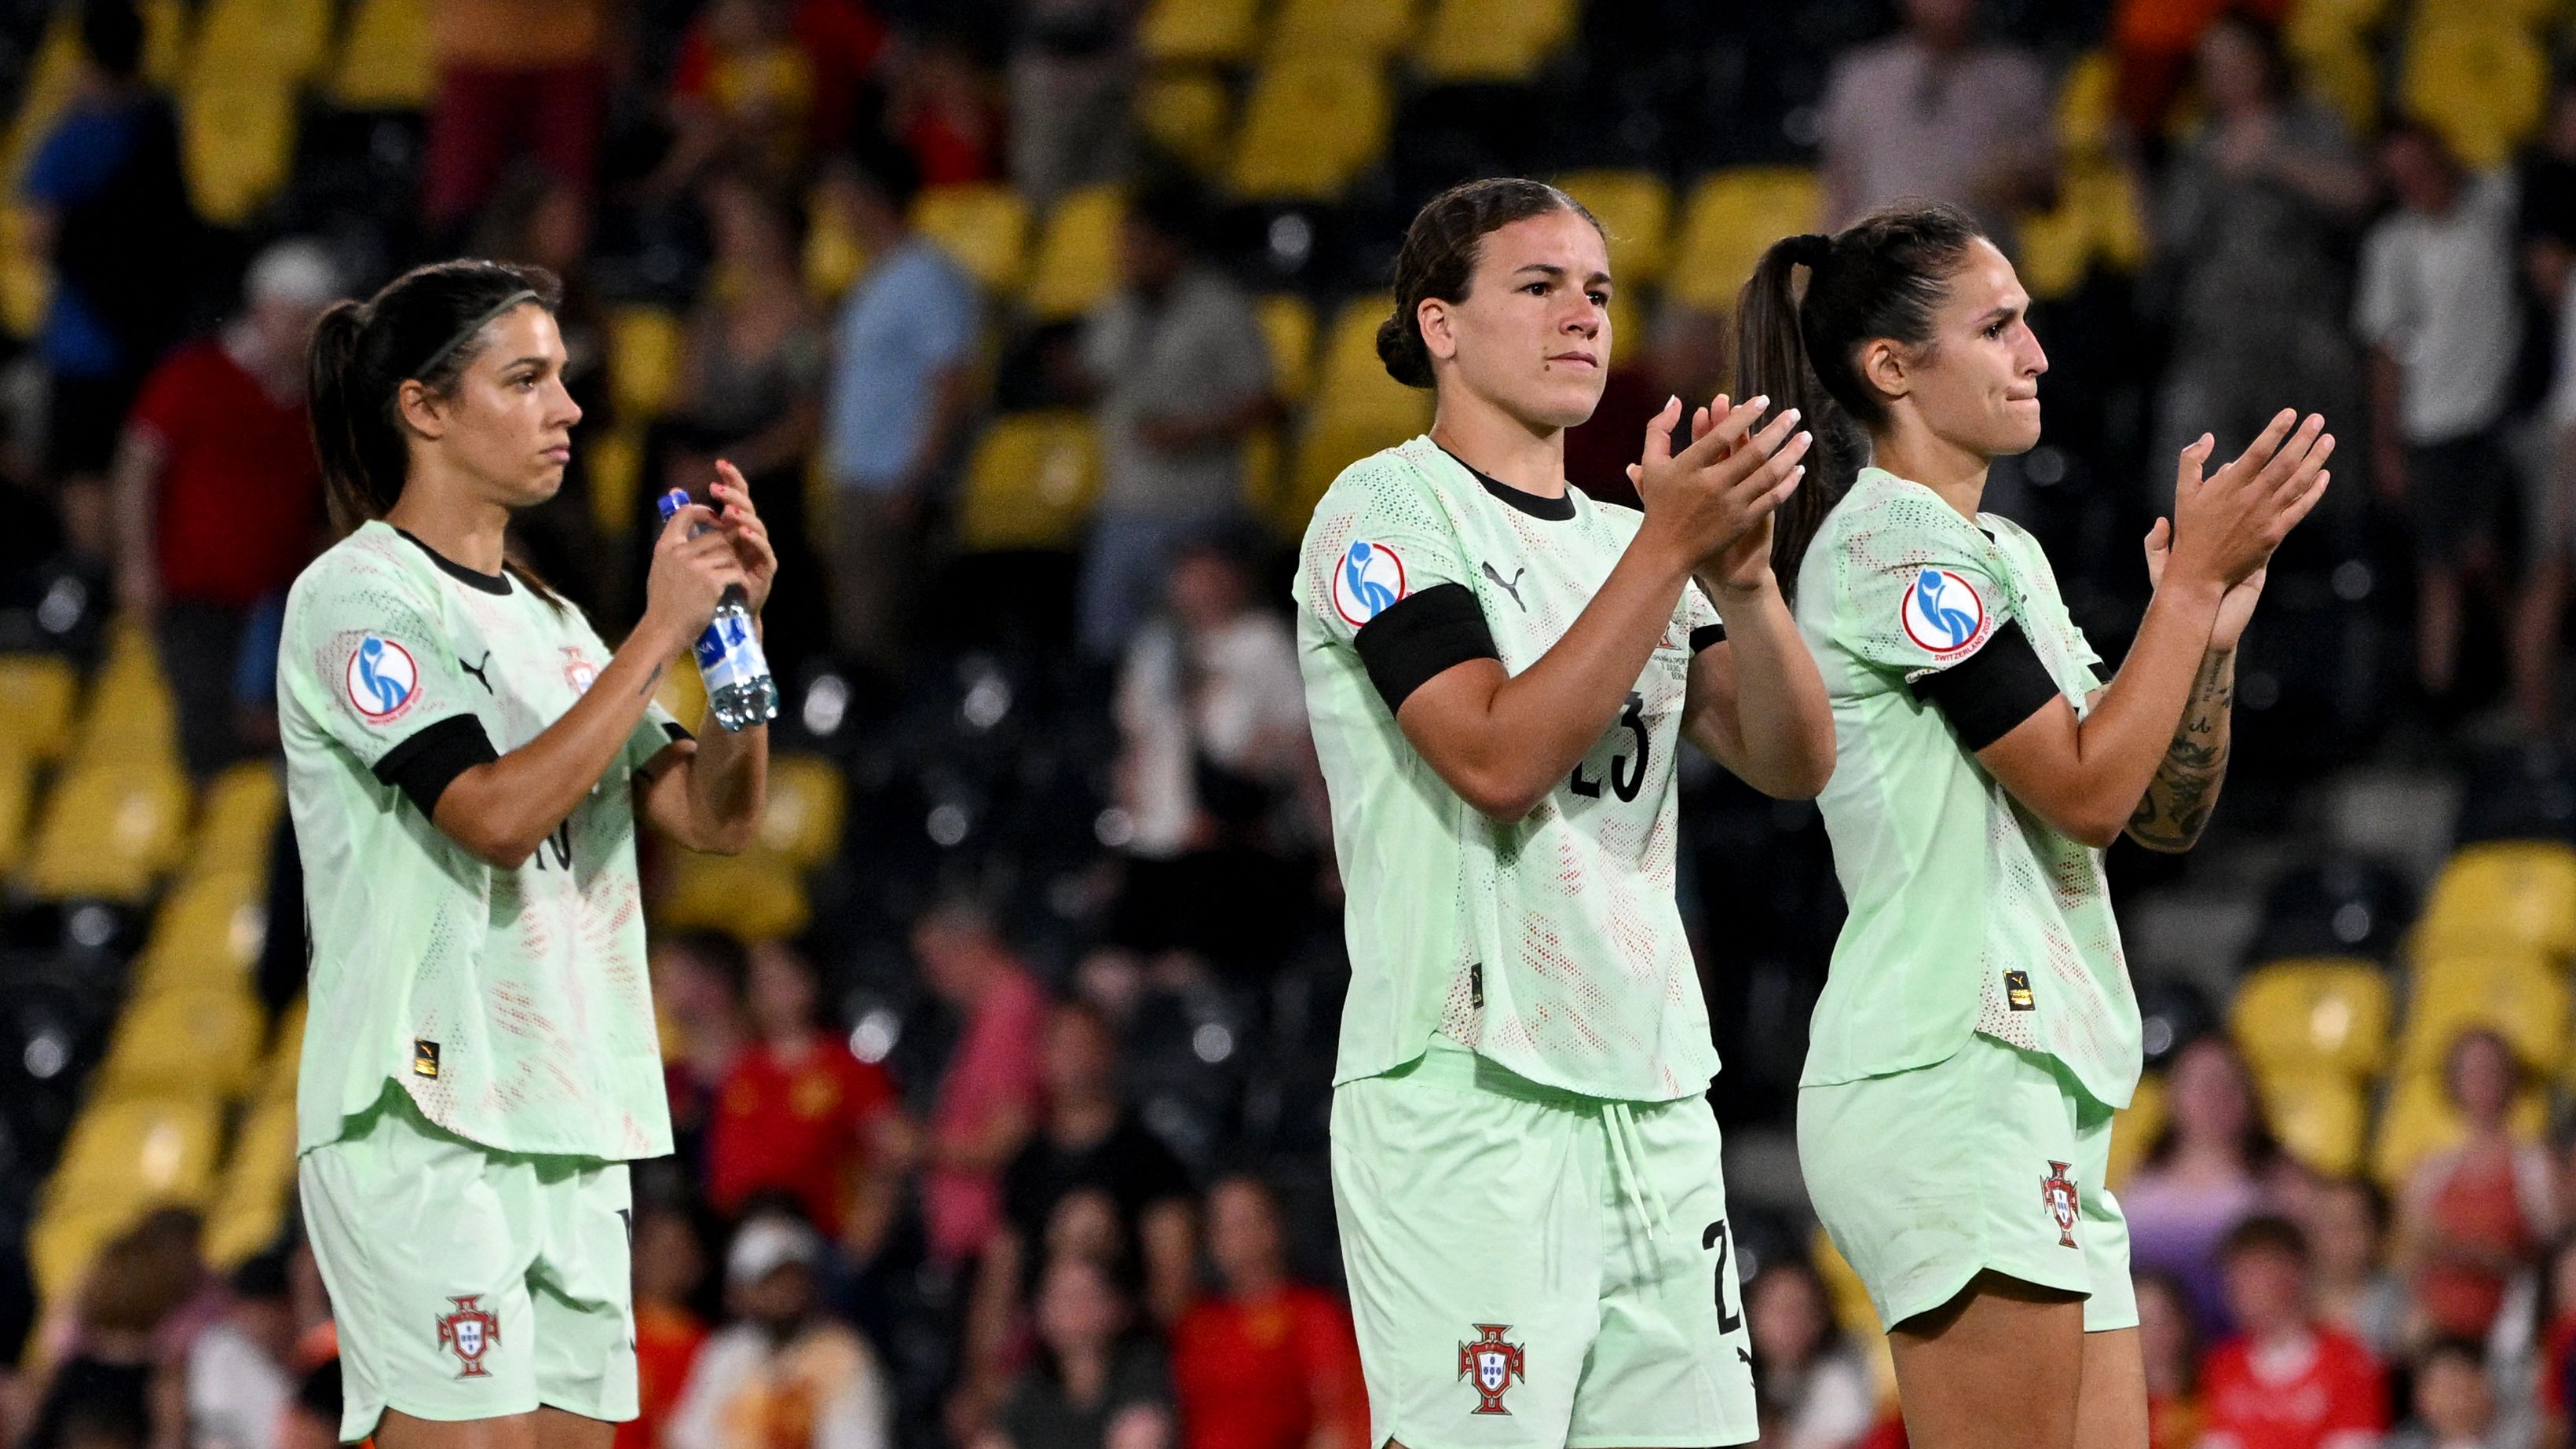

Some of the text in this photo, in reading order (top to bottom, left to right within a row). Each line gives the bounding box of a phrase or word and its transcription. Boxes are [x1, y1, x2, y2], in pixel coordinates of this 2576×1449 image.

[1934, 616, 1992, 661] SWITZERLAND 2025
[1701, 1218, 1742, 1336] 2
